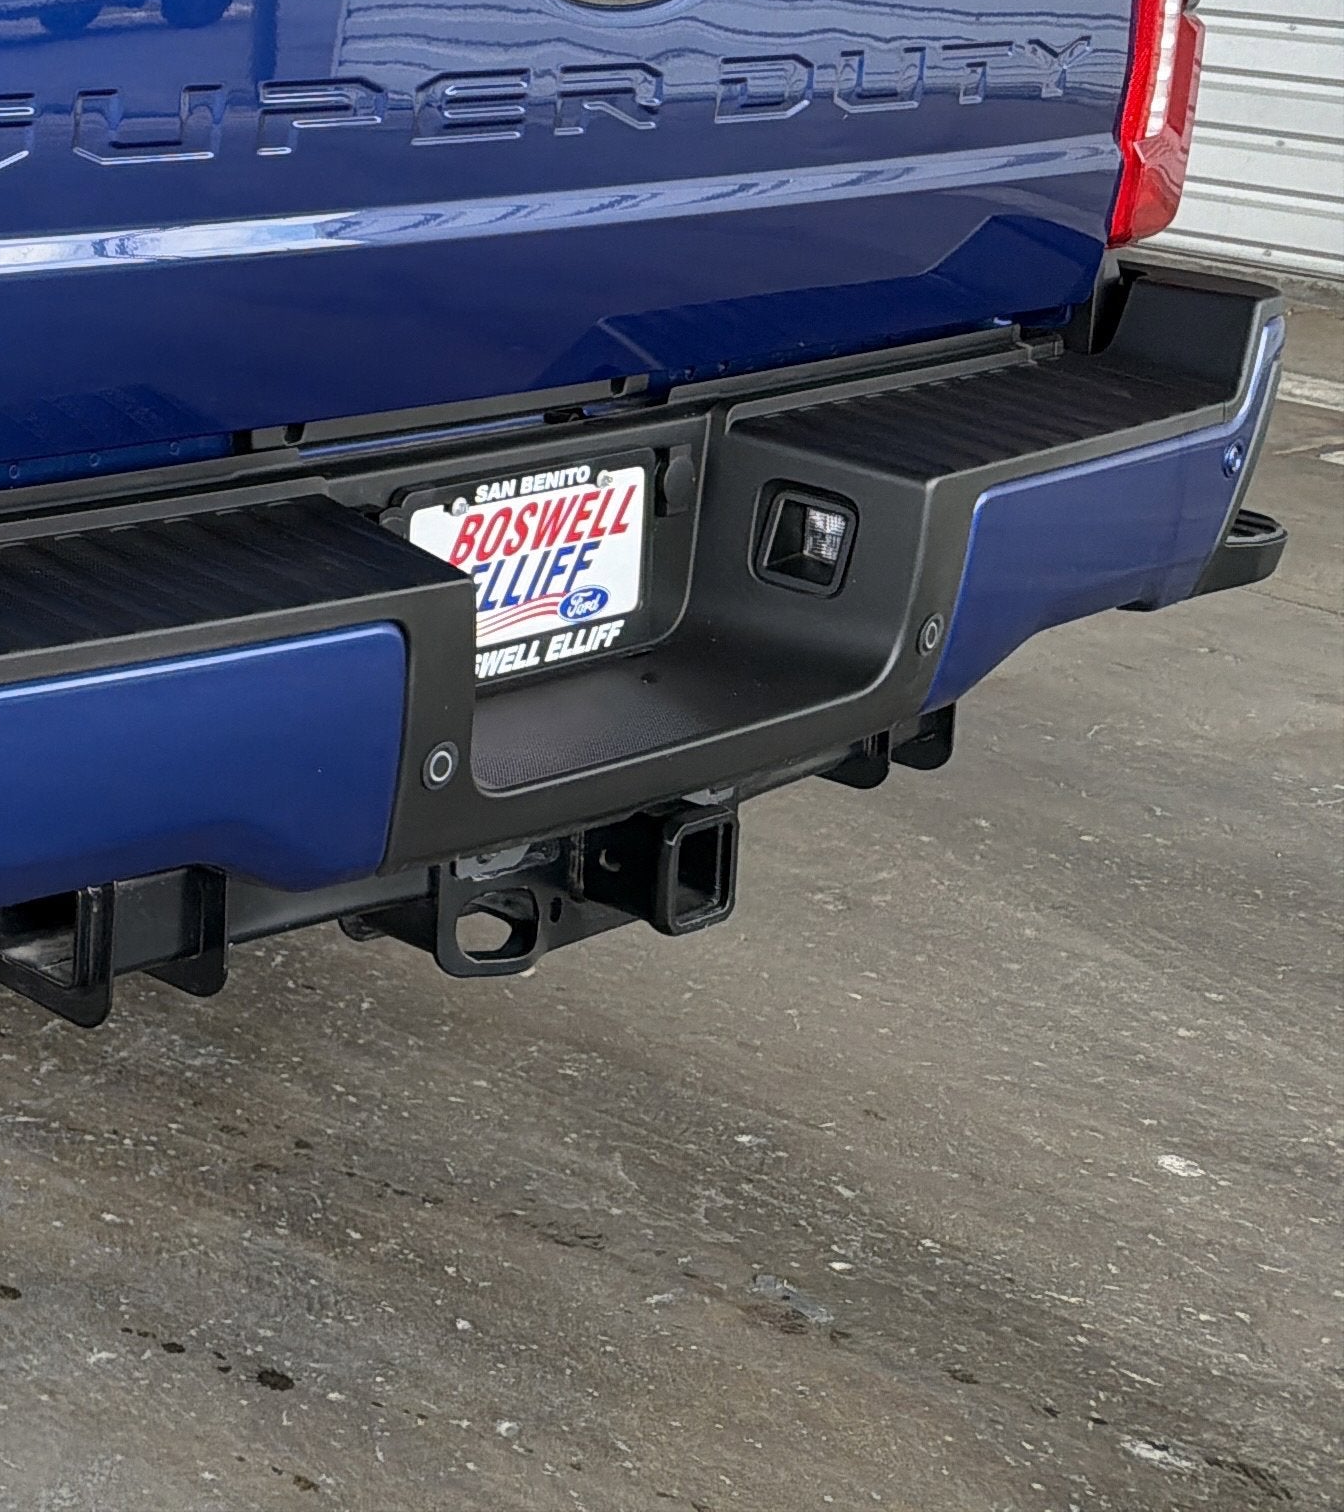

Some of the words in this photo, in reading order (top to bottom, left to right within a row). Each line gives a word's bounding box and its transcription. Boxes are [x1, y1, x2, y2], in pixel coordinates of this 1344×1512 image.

[714, 33, 1094, 125] DUTY
[474, 480, 516, 503] SAN
[520, 465, 591, 494] BENITO
[448, 485, 637, 566] BOSWELL
[567, 587, 604, 617] Ford
[544, 619, 625, 664] ELLIFF
